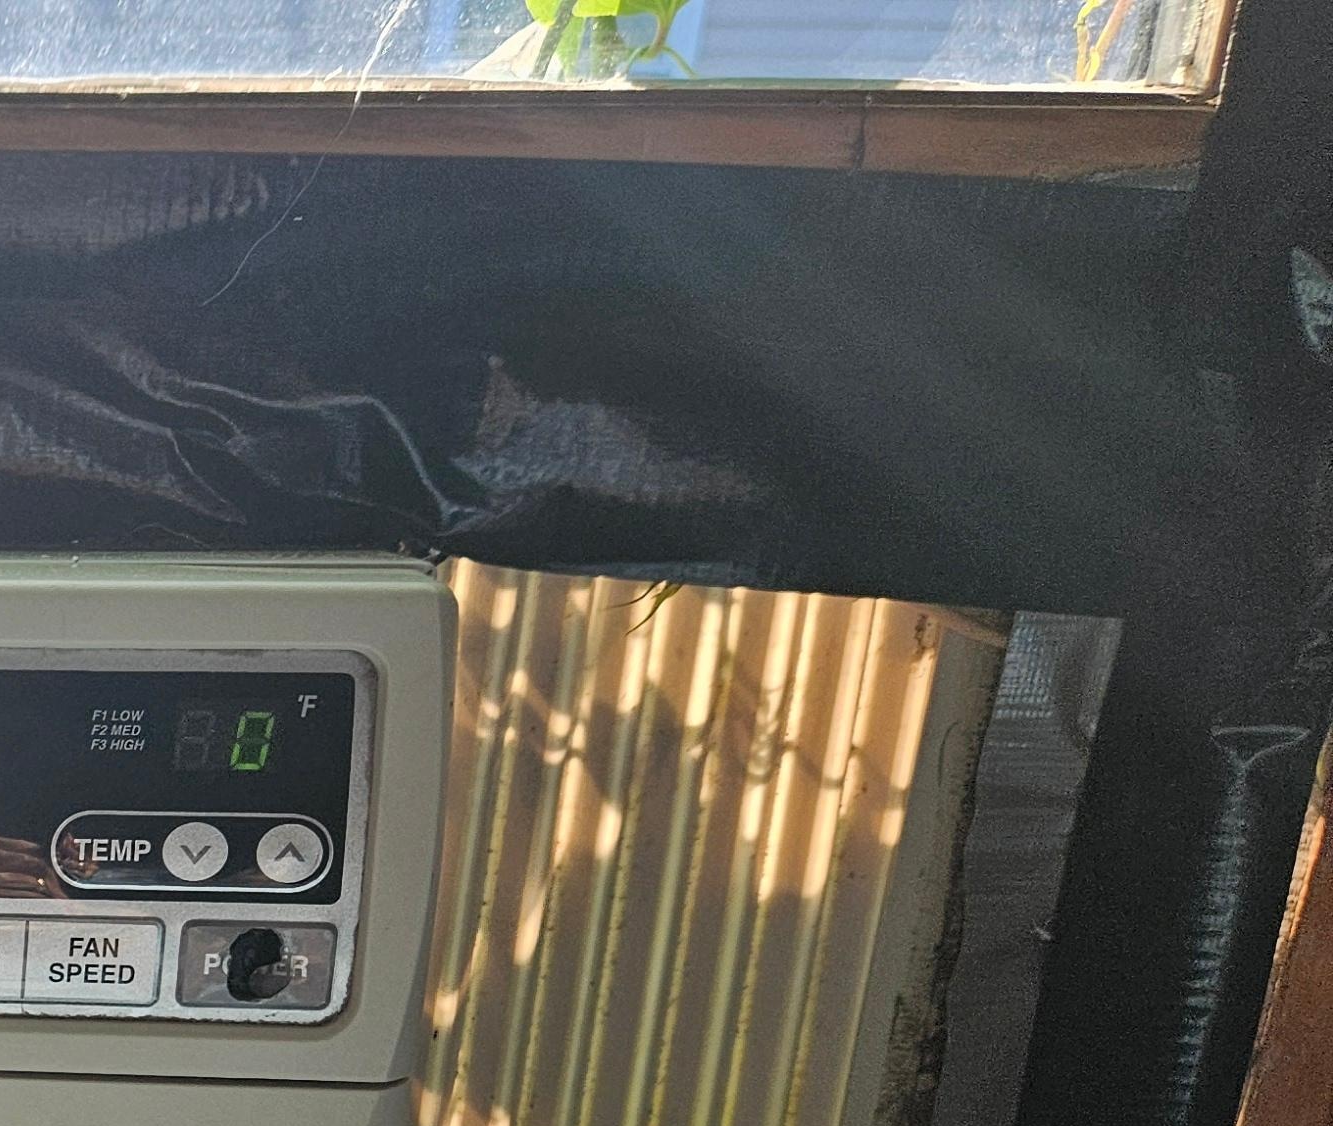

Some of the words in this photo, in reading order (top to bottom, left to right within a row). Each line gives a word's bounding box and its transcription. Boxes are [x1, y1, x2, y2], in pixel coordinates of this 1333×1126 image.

[91, 709, 108, 722] F1
[111, 709, 145, 722] LOW
[90, 724, 107, 737] F2
[110, 724, 142, 737] MED
[230, 711, 275, 771] 0
[90, 738, 107, 751] F3
[109, 738, 145, 752] HIGH
[73, 837, 152, 864] TEMP
[68, 937, 120, 959] FAN
[48, 962, 136, 985] SPEED
[203, 952, 309, 979] PER
